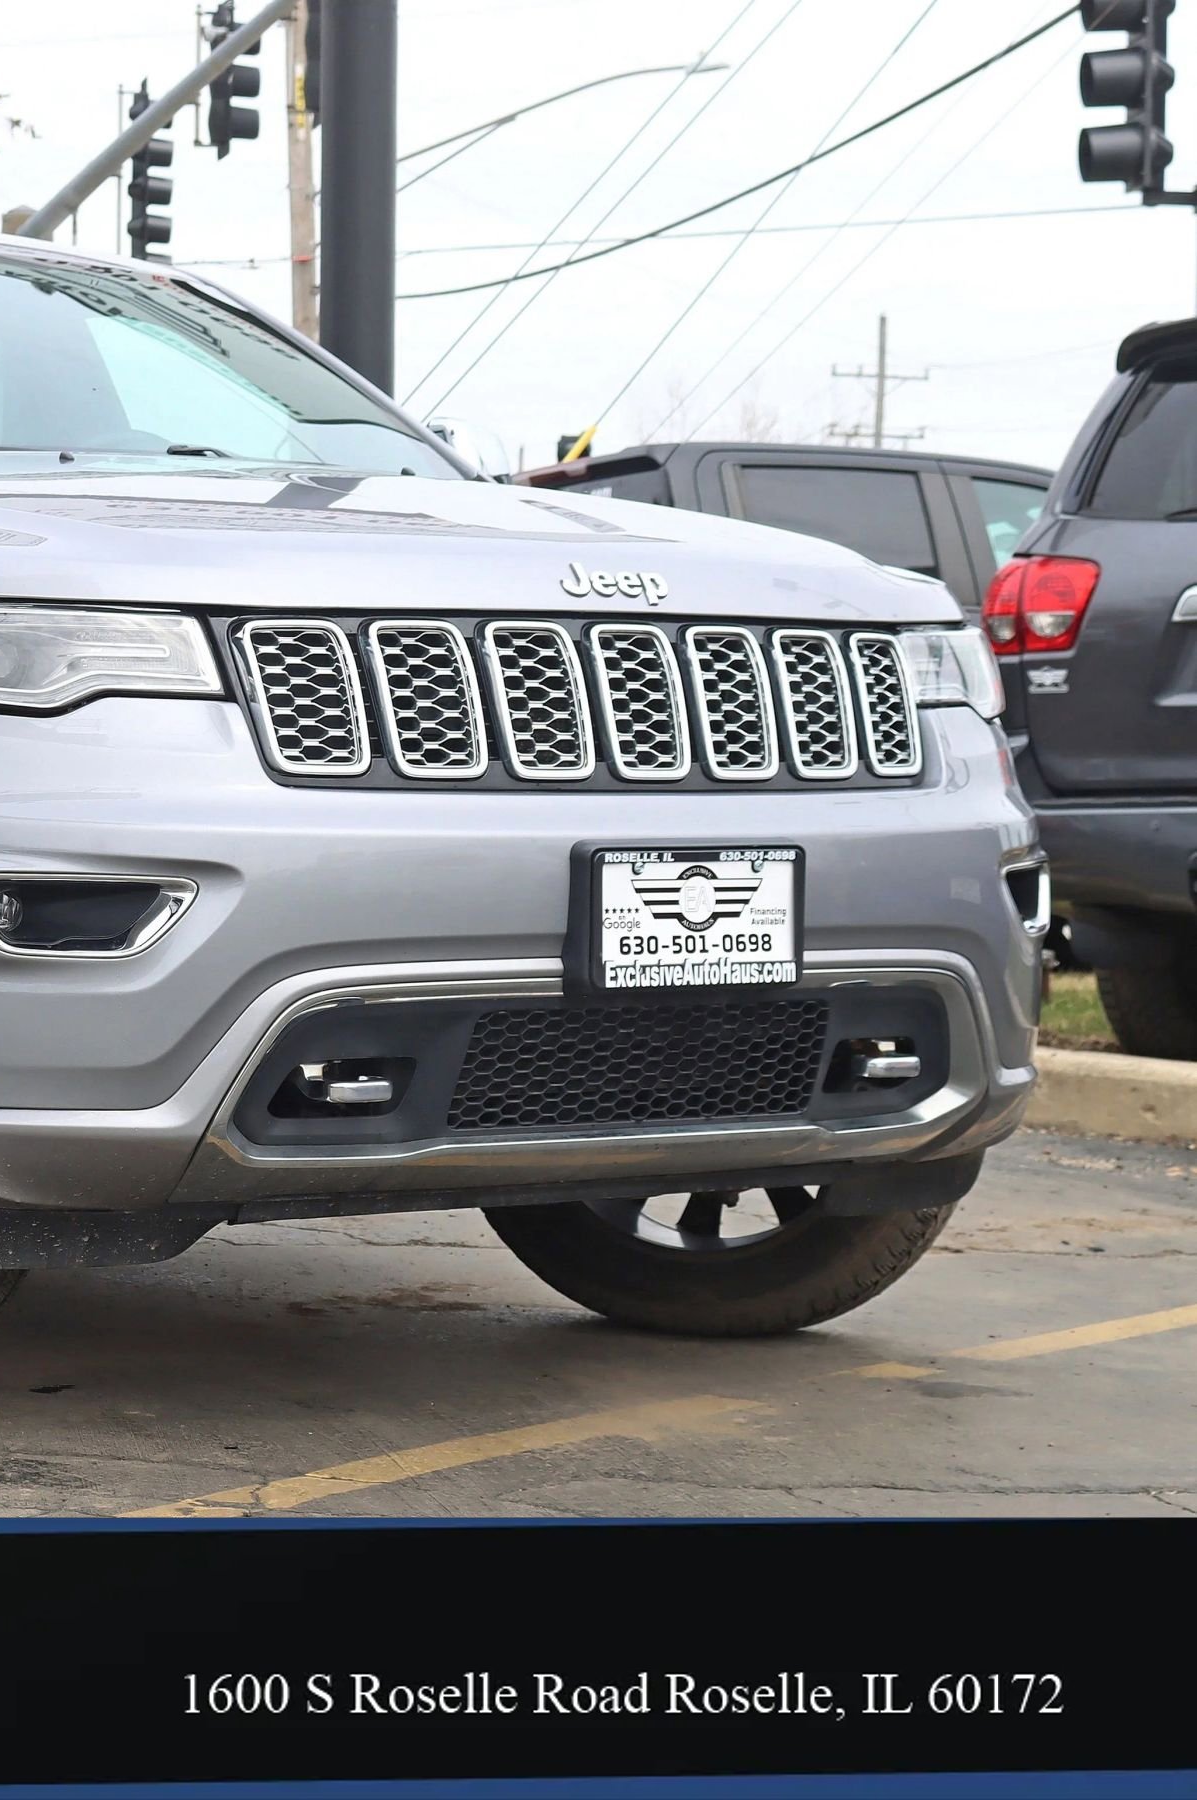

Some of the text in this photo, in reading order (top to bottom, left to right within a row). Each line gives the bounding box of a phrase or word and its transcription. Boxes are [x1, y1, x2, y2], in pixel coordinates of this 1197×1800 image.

[560, 562, 669, 606] Jeep
[604, 852, 675, 863] ROSELLE, IL
[719, 850, 797, 861] 630-501-0698
[750, 907, 787, 917] Financing
[603, 917, 641, 932] Google
[751, 918, 785, 926] Available
[619, 933, 773, 955] 630-501-0698
[605, 957, 796, 988] ExclusiveAutoHaus.com
